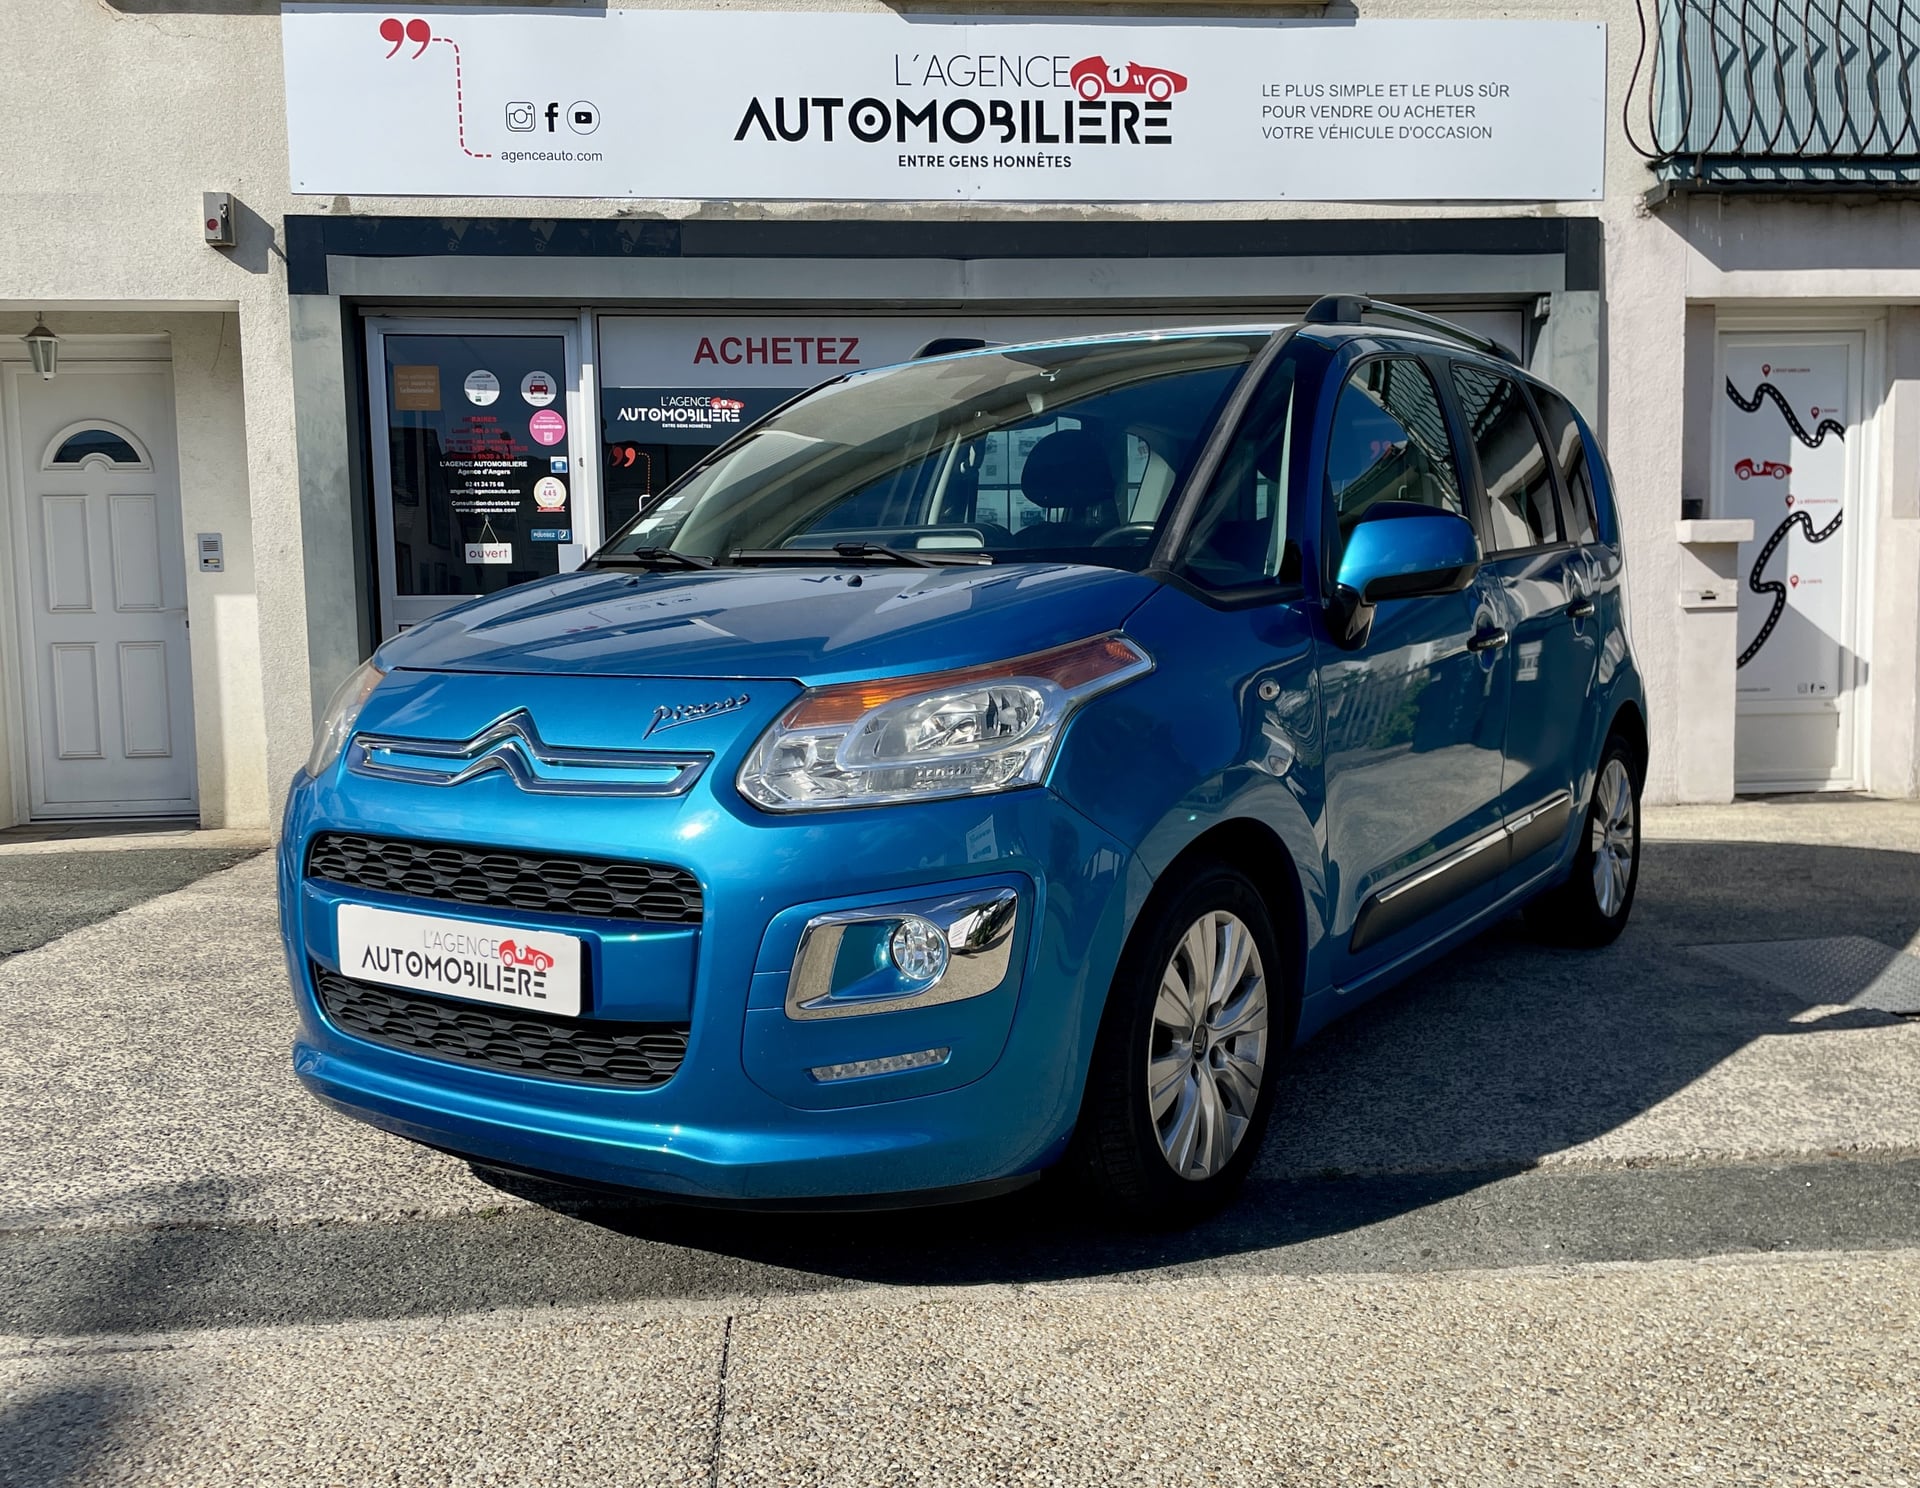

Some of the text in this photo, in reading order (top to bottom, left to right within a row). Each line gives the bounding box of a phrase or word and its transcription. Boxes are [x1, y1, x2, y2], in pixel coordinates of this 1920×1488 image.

[1262, 81, 1510, 98] LE PLUS SIMPLE ET LE PLUS SÛR
[1262, 105, 1476, 118] POUR VENDRE OU ACHETER
[1262, 123, 1493, 139] VOTRE VÉHICULE D'OCCASION
[501, 149, 603, 164] agenceauto.com
[898, 151, 1072, 168] ENTRE GENS HONNÊTES
[693, 337, 861, 365] ACHETEZ
[482, 468, 511, 476] d'Angers
[469, 548, 508, 559] ouvert
[423, 929, 500, 960] L'AGENCE
